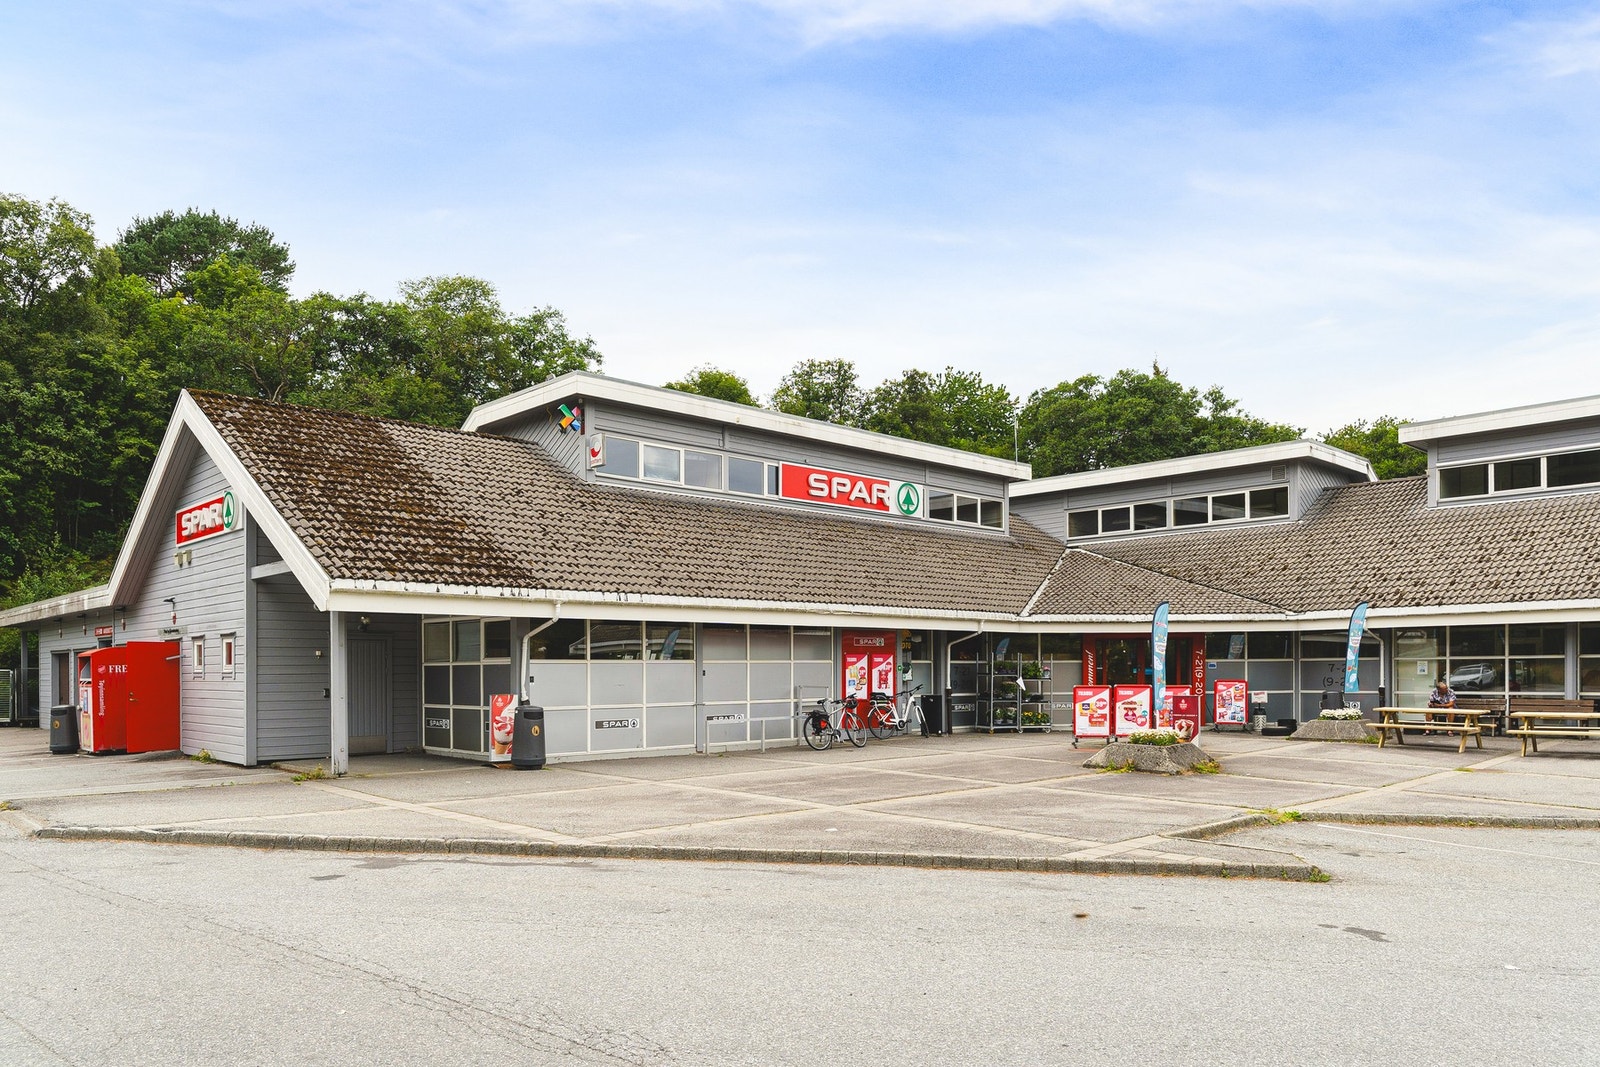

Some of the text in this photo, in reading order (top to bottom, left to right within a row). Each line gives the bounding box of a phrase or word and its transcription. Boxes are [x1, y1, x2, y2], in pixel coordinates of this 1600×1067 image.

[808, 473, 890, 506] SPAR
[181, 503, 223, 537] SPAR
[108, 664, 128, 673] FRE
[1085, 650, 1093, 686] ommen!
[1328, 663, 1345, 673] 7-2
[430, 719, 443, 727] SPAR
[602, 720, 628, 728] SPAR
